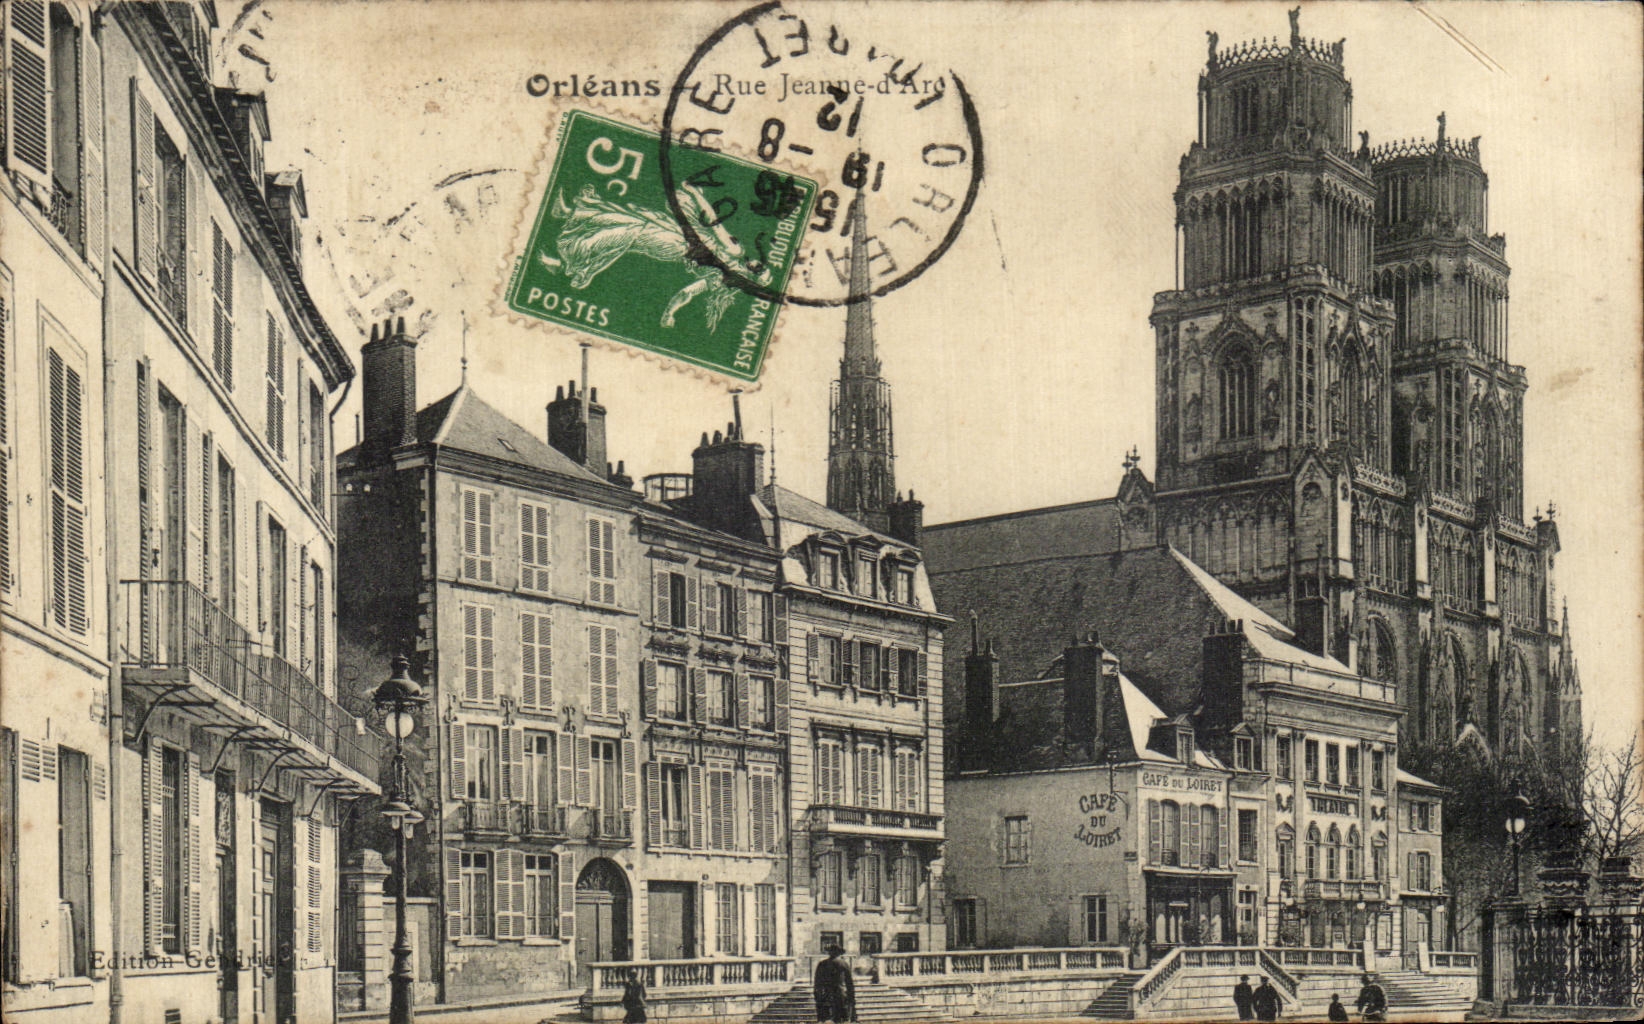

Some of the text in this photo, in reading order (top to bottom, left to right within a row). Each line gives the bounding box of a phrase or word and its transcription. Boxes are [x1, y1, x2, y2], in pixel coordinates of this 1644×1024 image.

[1172, 778, 1184, 789] DU
[1187, 777, 1223, 792] LOIRET
[1090, 815, 1107, 828] DU
[1073, 823, 1122, 849] LOIRET
